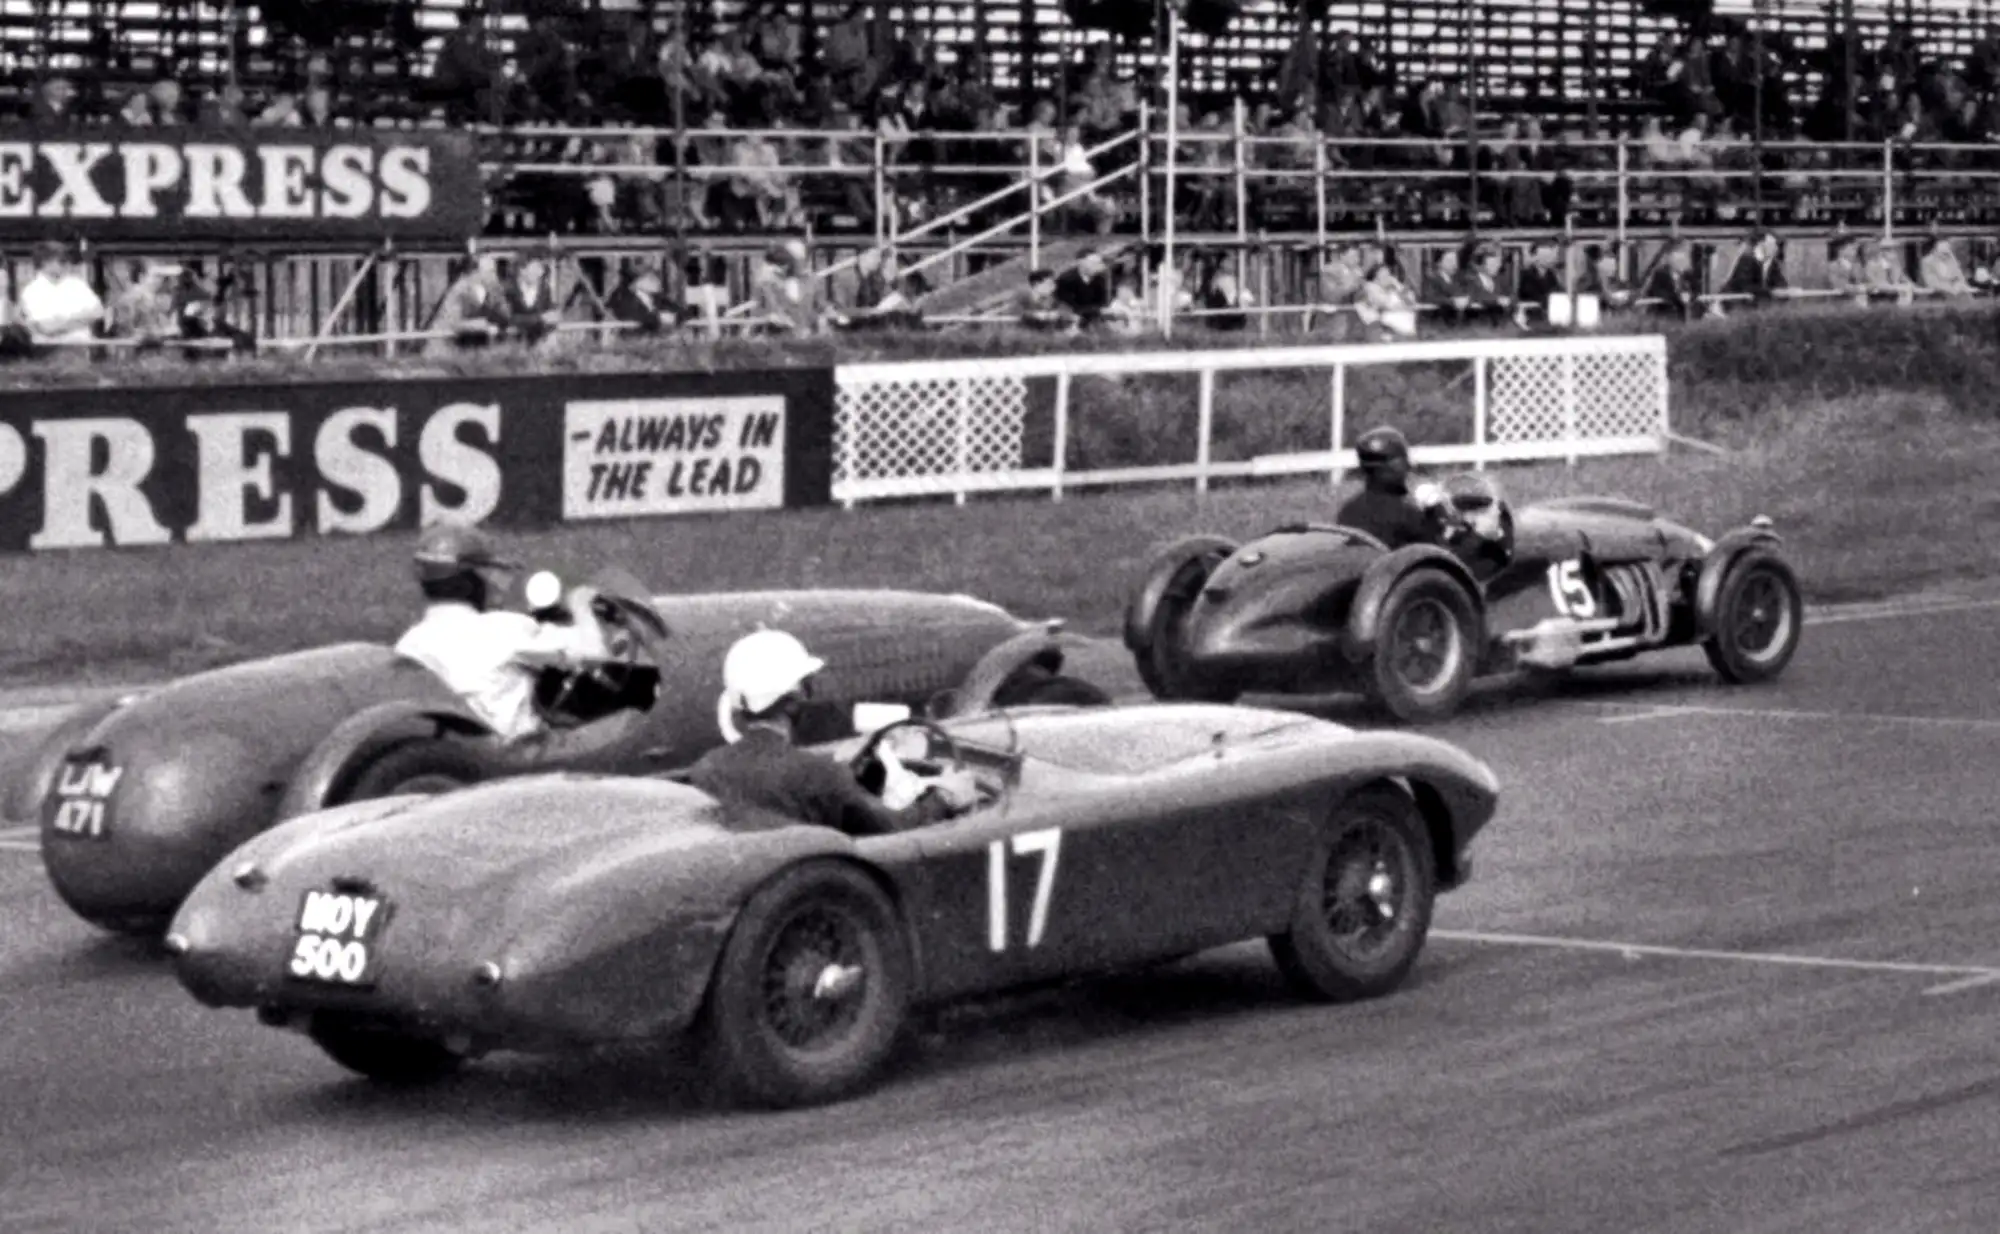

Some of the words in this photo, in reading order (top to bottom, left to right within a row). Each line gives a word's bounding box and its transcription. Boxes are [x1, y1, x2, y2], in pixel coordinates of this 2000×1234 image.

[0, 142, 431, 218] EXPRESS
[739, 411, 779, 449] IN
[0, 403, 502, 549] RESS
[586, 462, 653, 502] THE
[667, 456, 763, 498] LEAD
[1546, 557, 1596, 618] 15
[988, 826, 1062, 952] 17
[290, 934, 367, 981] 500
